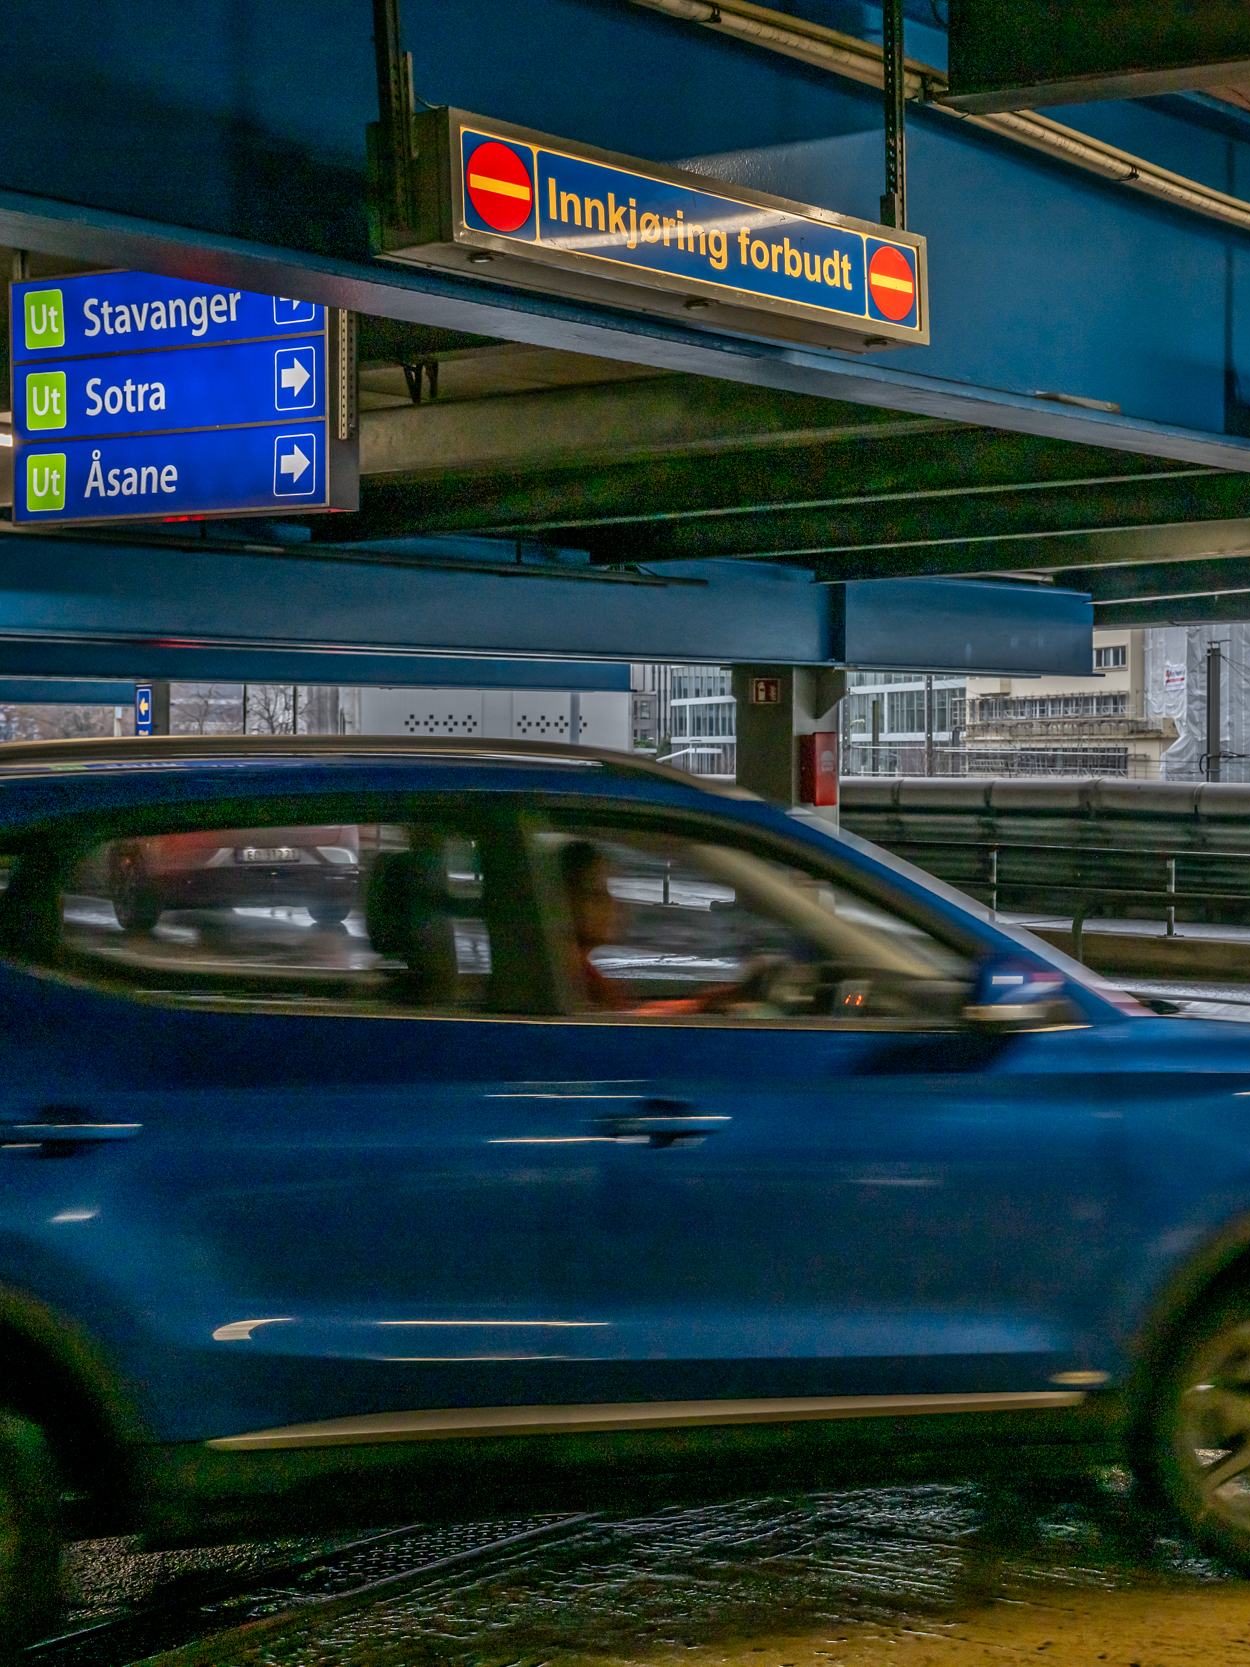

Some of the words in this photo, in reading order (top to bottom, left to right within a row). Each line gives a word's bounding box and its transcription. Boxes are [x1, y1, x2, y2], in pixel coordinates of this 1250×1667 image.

[547, 177, 728, 270] Innkjøring
[737, 226, 853, 291] forbudt
[30, 304, 59, 335] Ut
[83, 292, 242, 337] Stavanger
[32, 386, 61, 416] Ut
[85, 377, 166, 416] Sotra
[32, 466, 61, 497] Ut
[84, 450, 178, 498] Åsane
